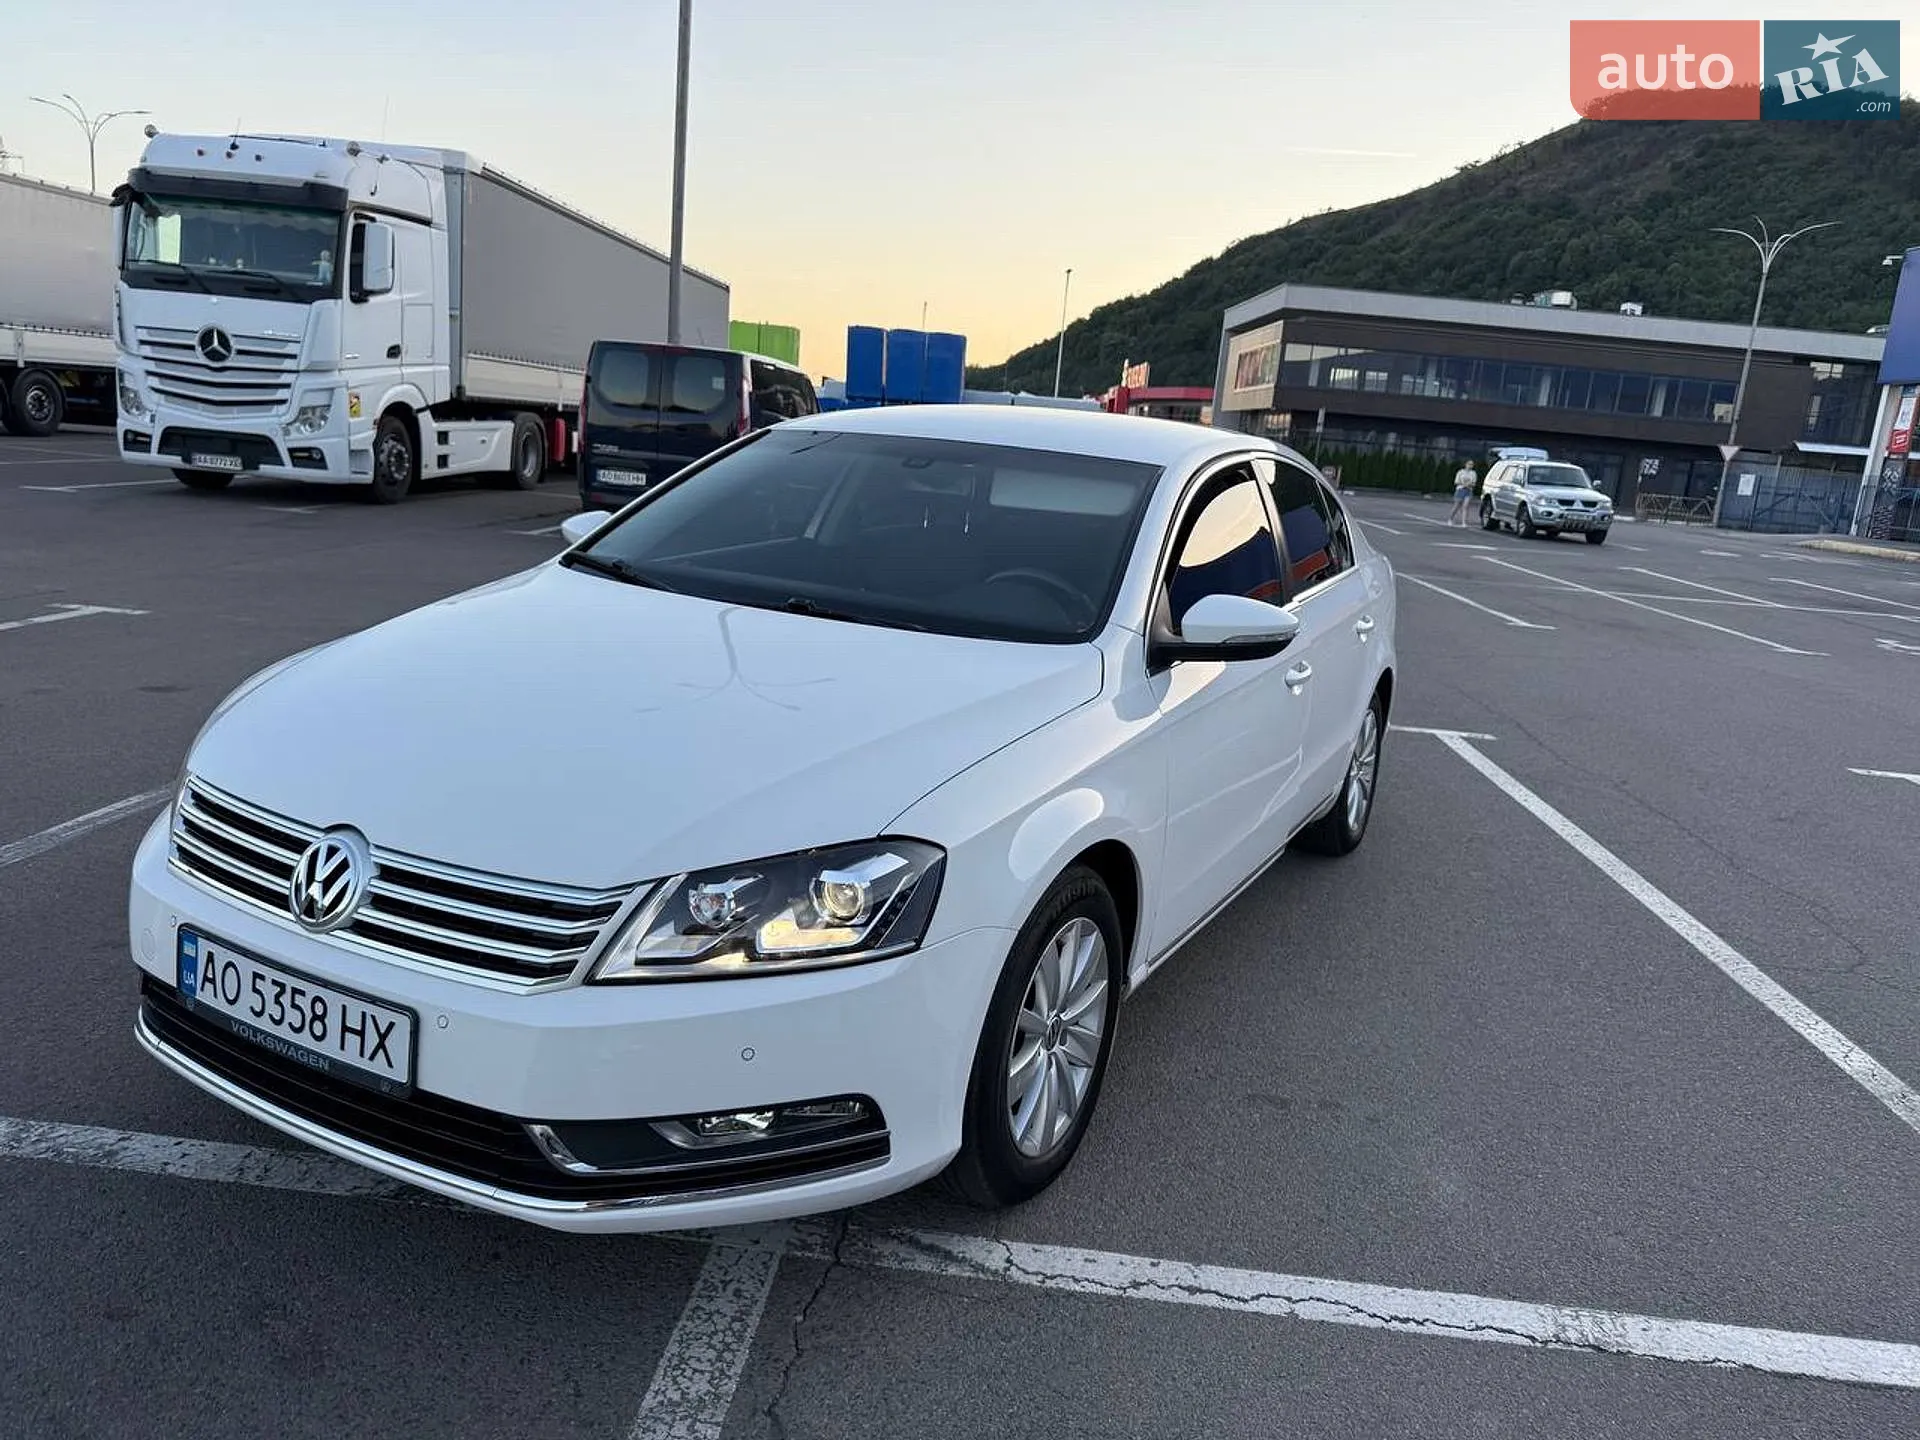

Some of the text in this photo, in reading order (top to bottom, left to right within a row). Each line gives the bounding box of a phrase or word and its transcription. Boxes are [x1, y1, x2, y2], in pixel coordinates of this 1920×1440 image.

[200, 950, 396, 1069] AO 5358 HX
[230, 1019, 330, 1072] VOLKSWAGEN
